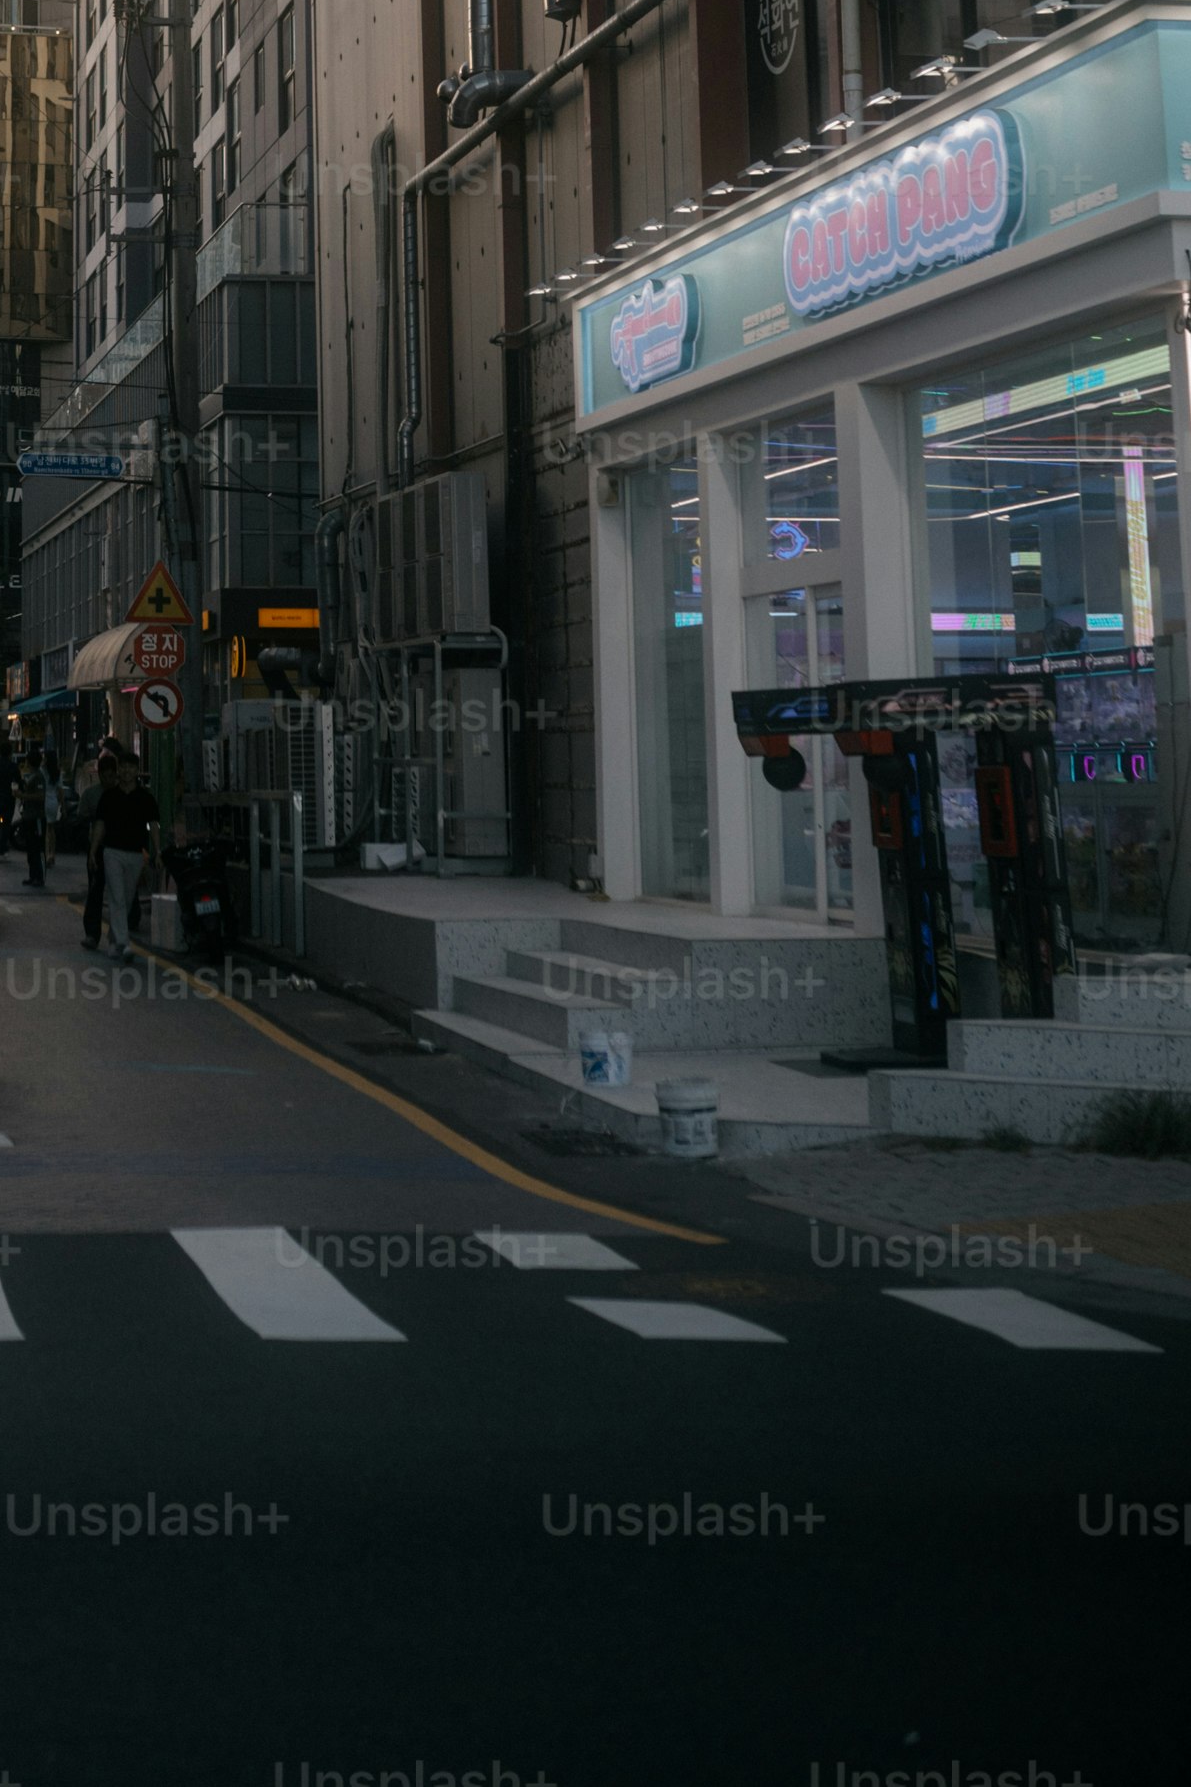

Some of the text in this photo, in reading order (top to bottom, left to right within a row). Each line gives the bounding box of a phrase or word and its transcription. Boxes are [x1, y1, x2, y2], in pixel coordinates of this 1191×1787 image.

[789, 137, 998, 292] CATCH PANG
[141, 633, 178, 652] 정지
[141, 654, 178, 669] STOP
